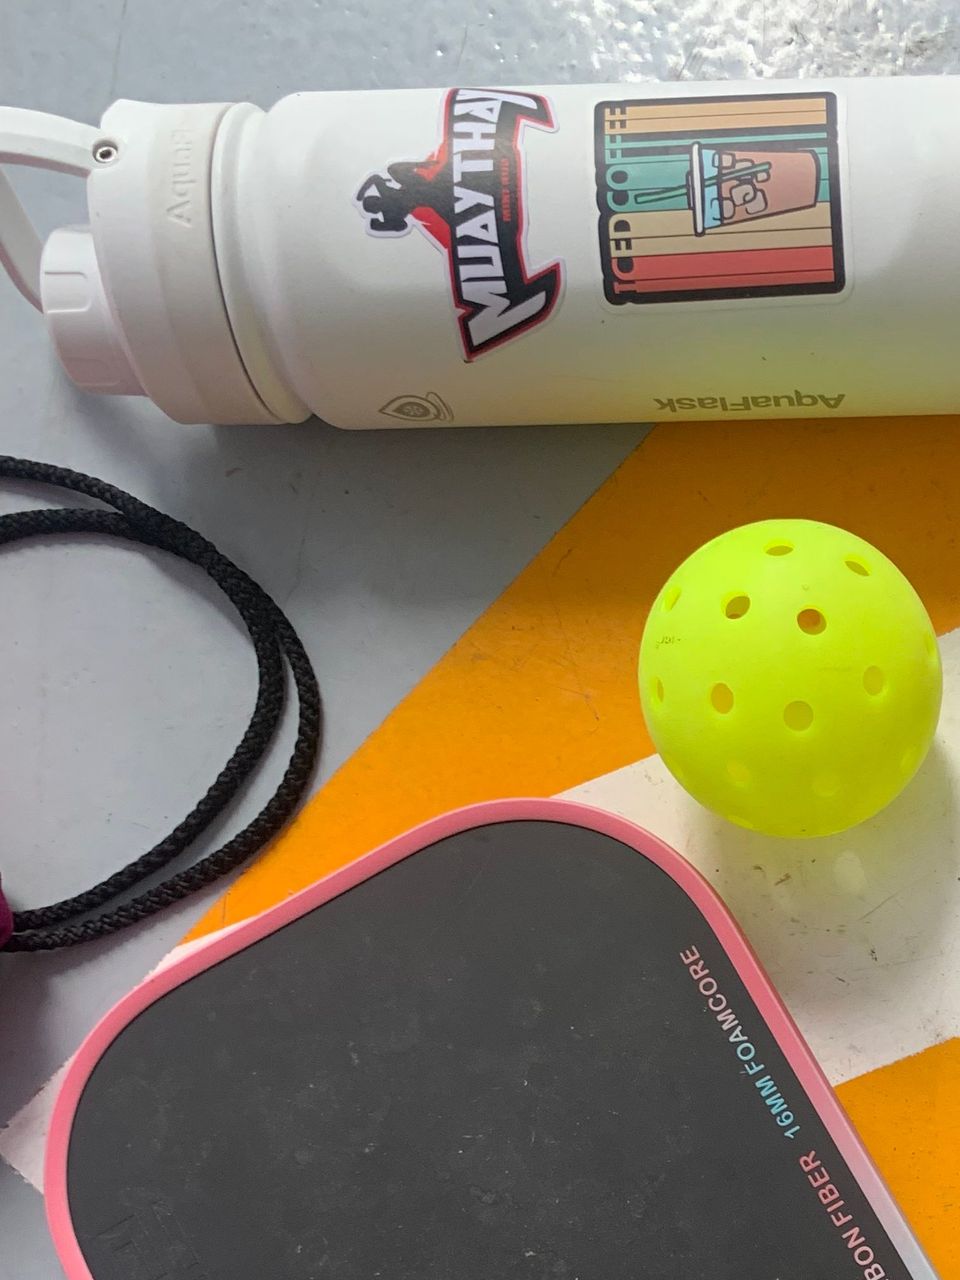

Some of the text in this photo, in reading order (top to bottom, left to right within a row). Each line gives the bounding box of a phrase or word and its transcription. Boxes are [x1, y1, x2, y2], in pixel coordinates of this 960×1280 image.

[605, 104, 634, 294] ICED COFFEE
[653, 389, 845, 413] AquaFlask
[679, 944, 766, 1075] FOAMCORE
[754, 1074, 801, 1139] 16MM
[799, 1150, 853, 1228] FIBER
